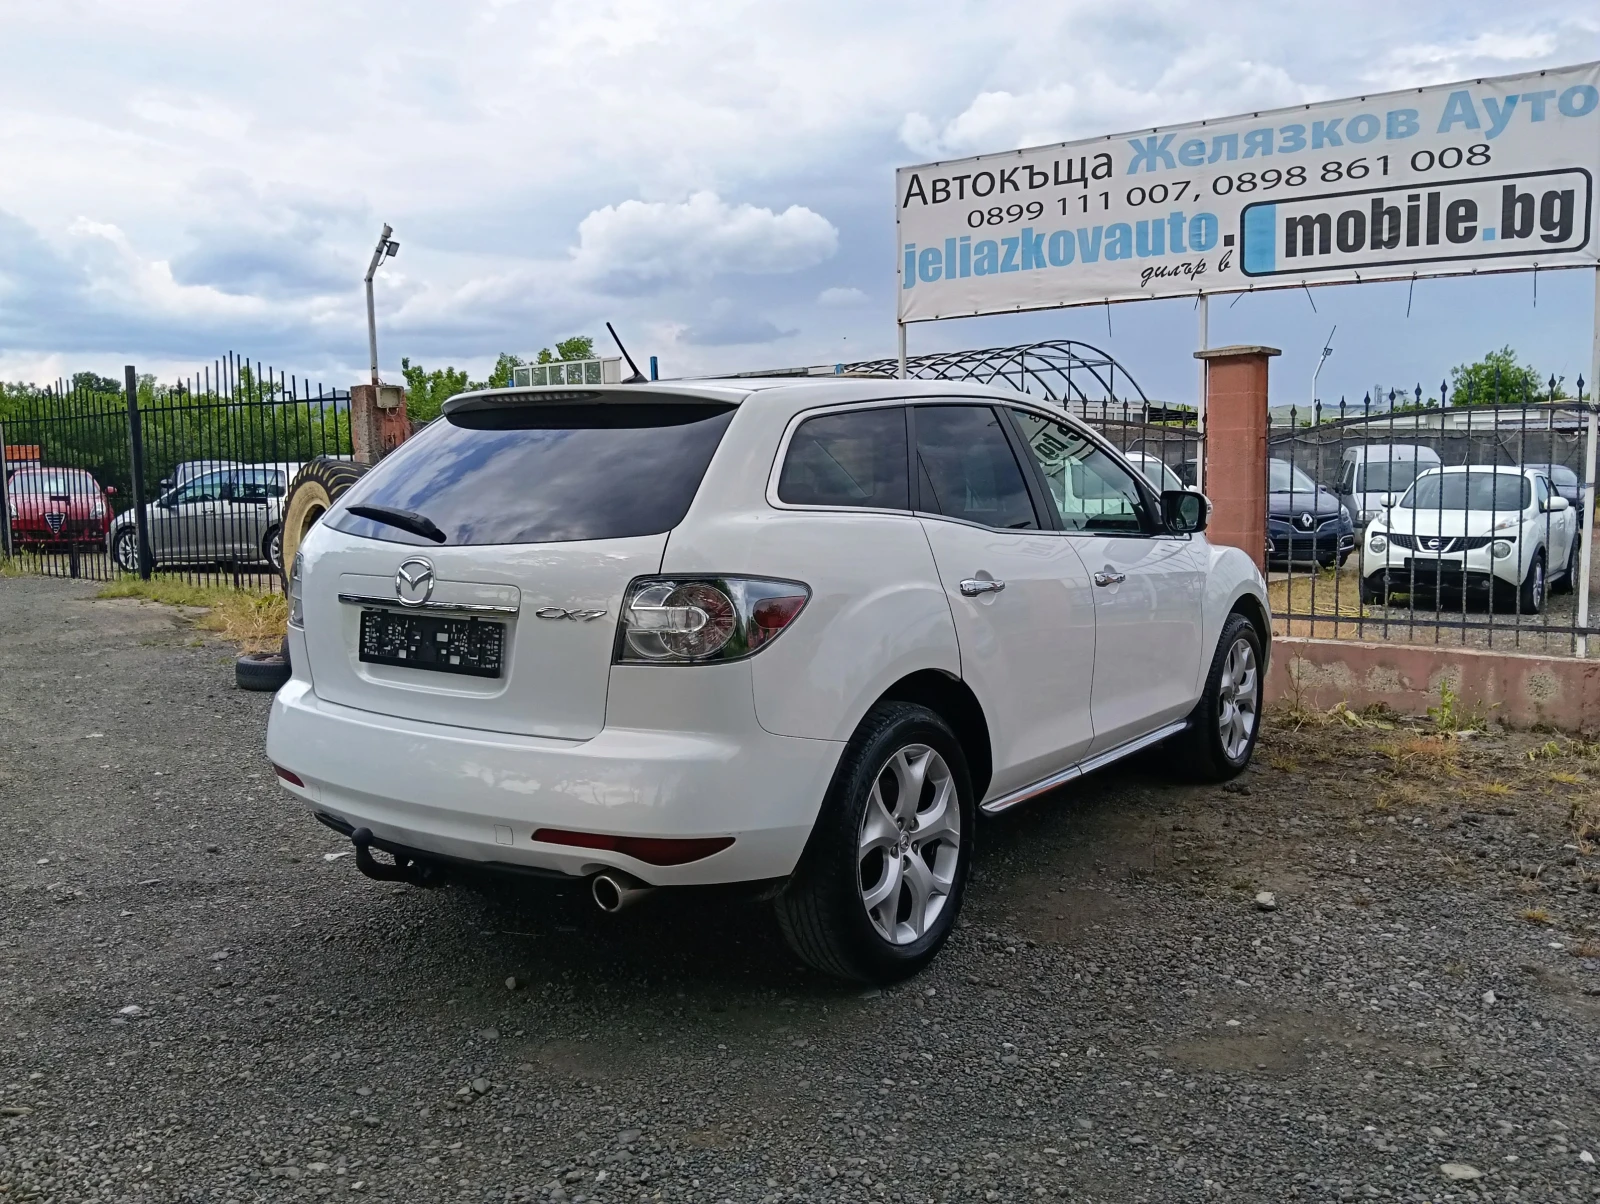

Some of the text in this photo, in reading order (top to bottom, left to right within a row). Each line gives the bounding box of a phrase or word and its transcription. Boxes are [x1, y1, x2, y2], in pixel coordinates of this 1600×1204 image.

[903, 85, 1600, 208] Автокъща Желязков Ауто
[967, 144, 1492, 228] 0899 111 007, 0898 861 008
[1285, 184, 1575, 258] mobile.bg
[535, 606, 608, 622] CX-7
